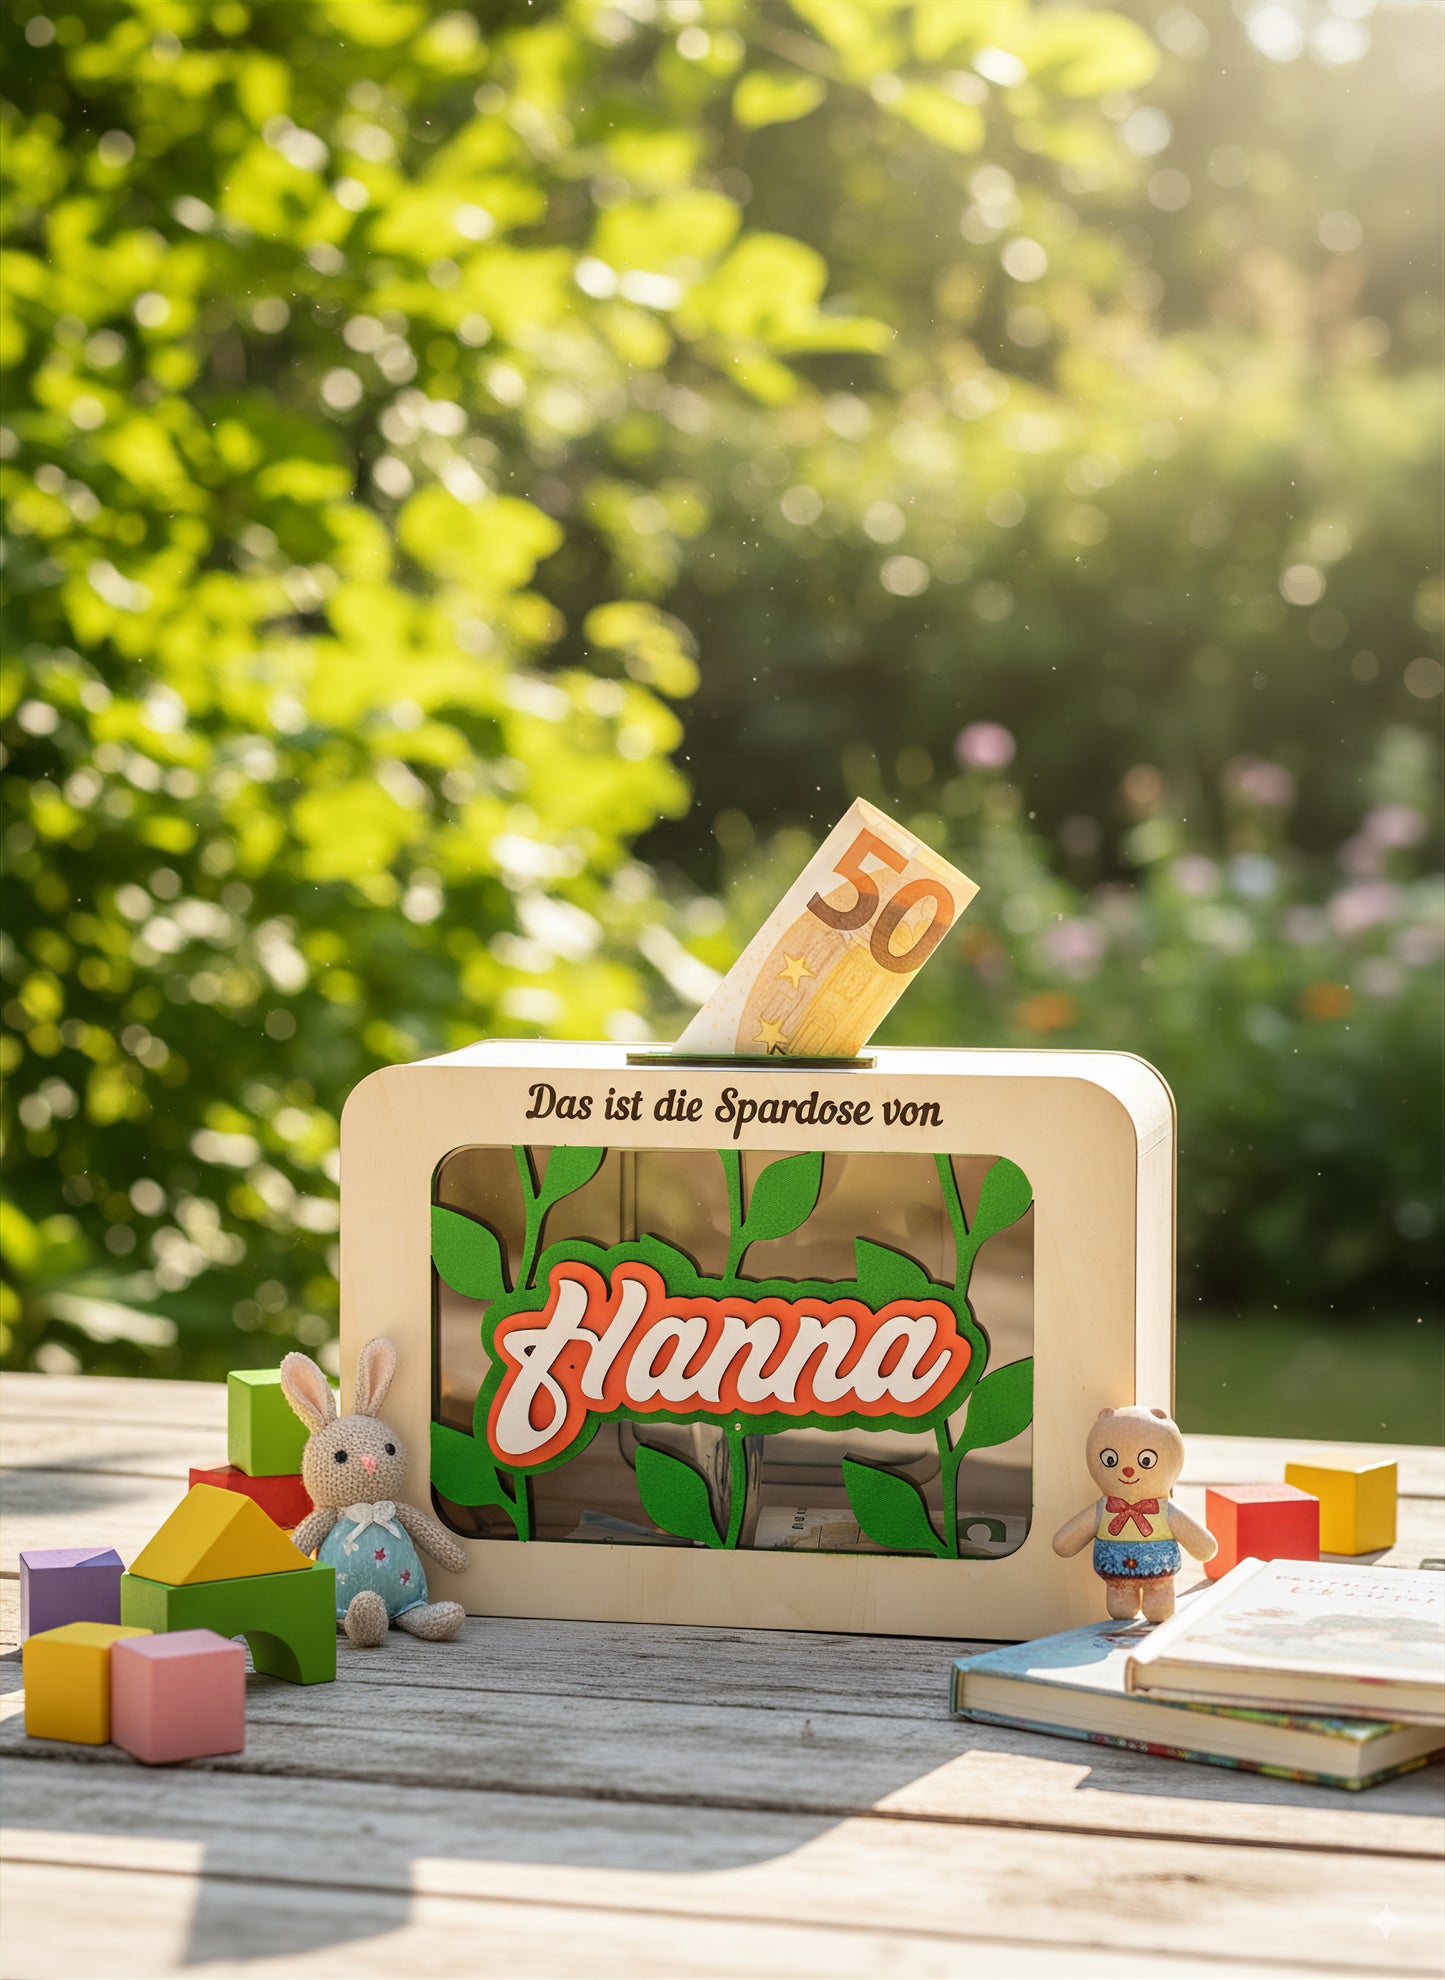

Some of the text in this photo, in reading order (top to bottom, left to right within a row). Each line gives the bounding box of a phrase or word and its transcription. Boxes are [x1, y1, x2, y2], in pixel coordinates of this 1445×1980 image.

[806, 827, 956, 974] 50
[525, 1083, 944, 1140] Das ist die Spardose von
[496, 1278, 952, 1455] Hanna
